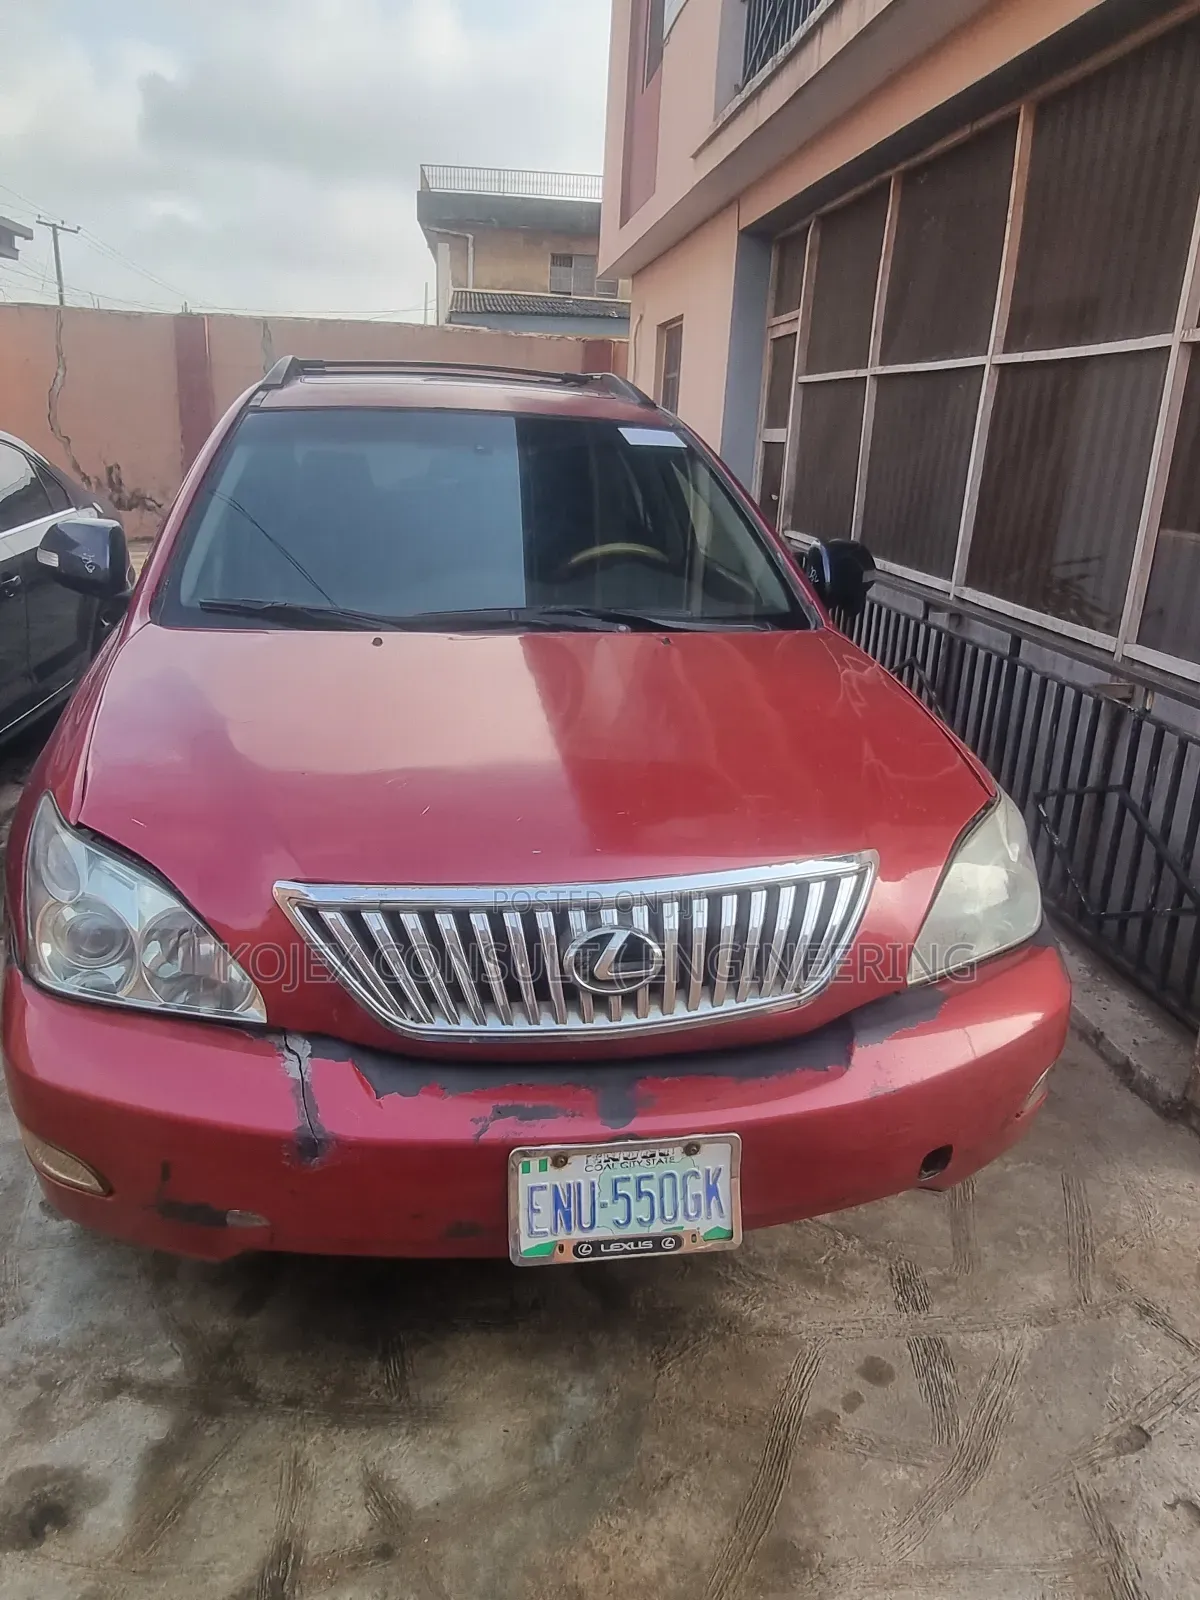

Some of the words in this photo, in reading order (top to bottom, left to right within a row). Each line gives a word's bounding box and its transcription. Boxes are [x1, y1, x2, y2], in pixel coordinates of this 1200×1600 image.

[584, 1163, 618, 1173] COAL
[620, 1159, 644, 1169] CITY
[646, 1156, 676, 1166] STATE
[527, 1166, 725, 1238] ENU-550GK
[600, 1240, 653, 1252] LEXUS
